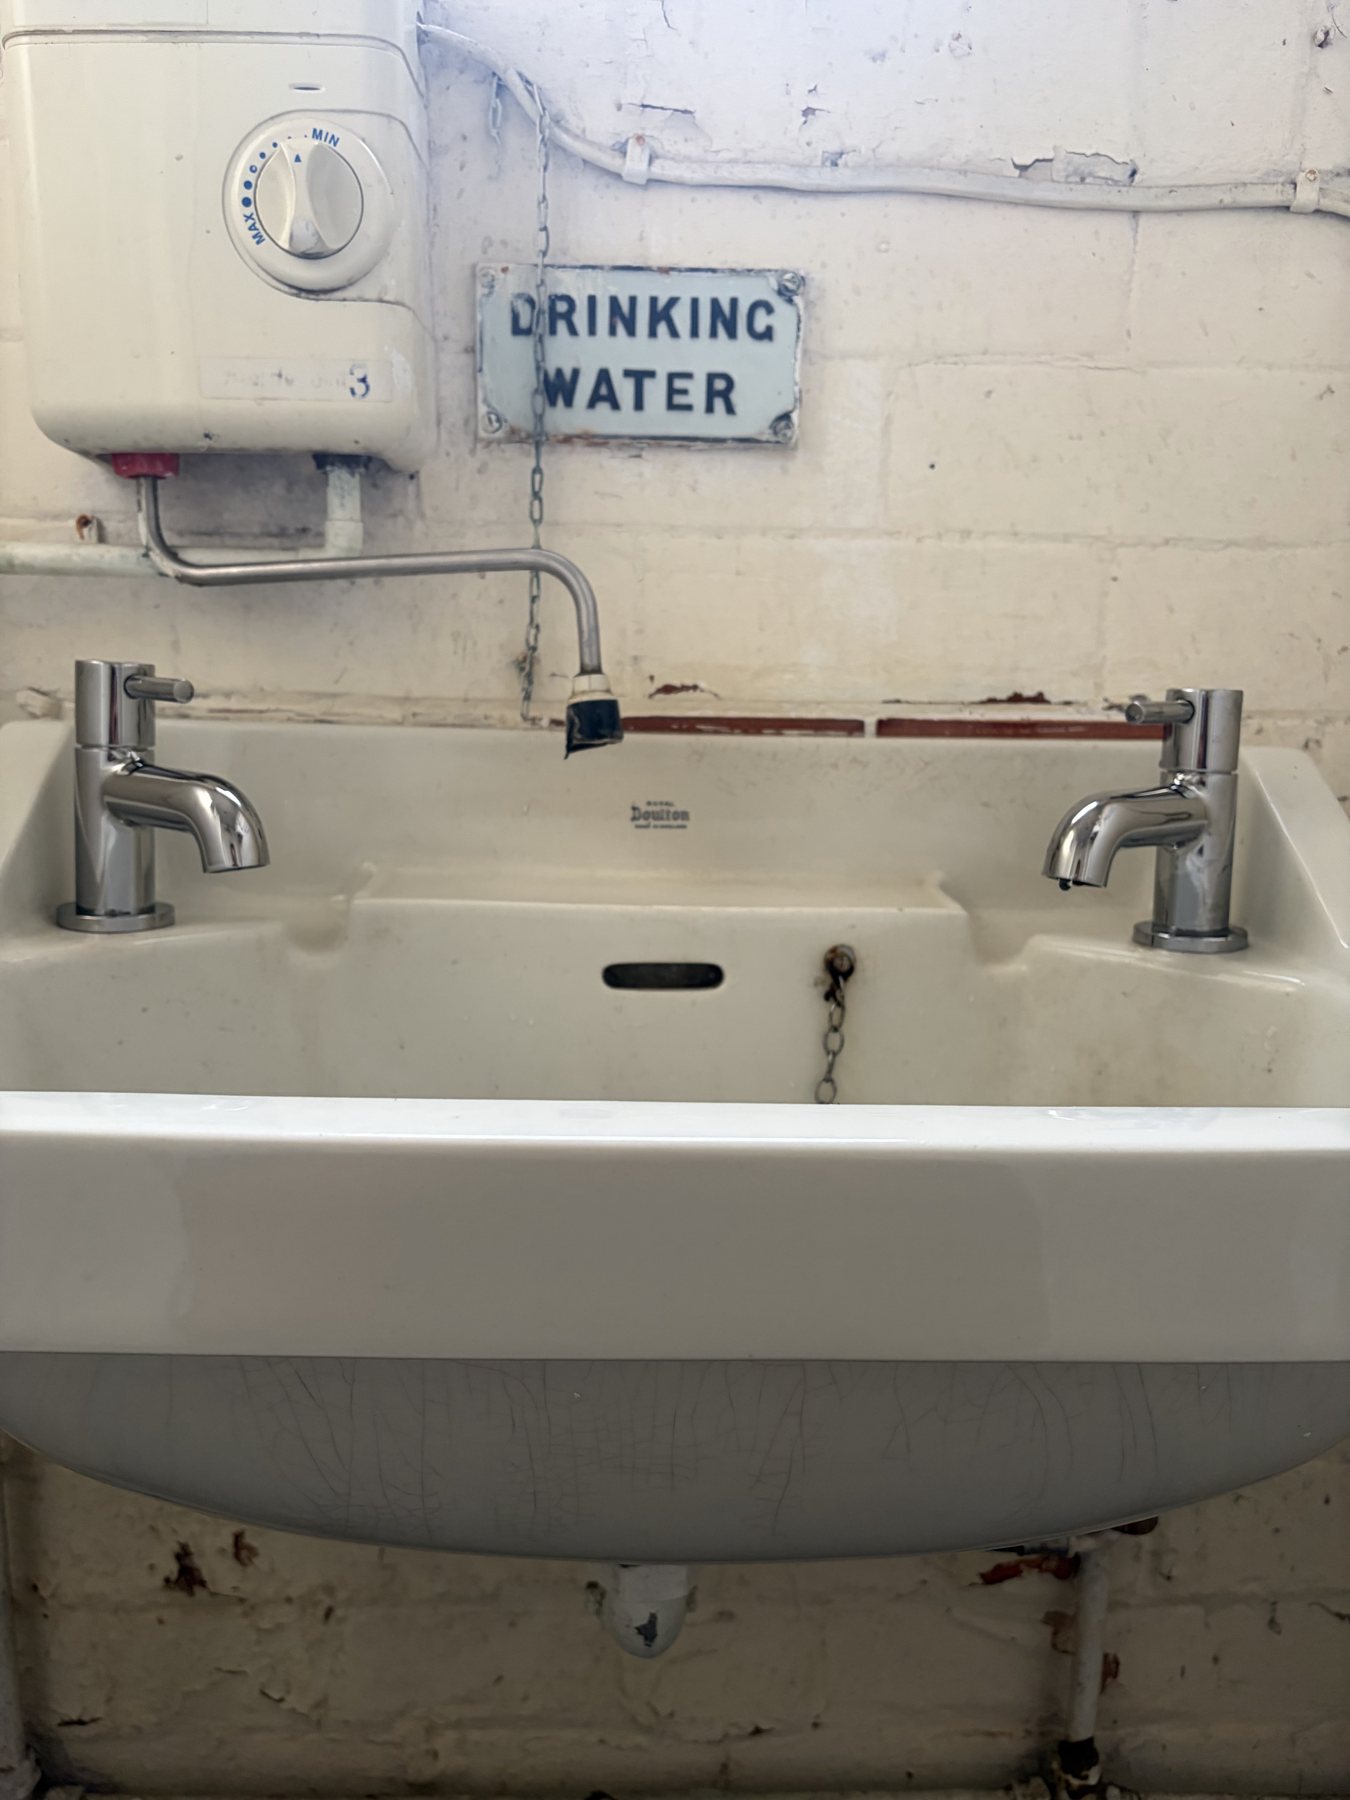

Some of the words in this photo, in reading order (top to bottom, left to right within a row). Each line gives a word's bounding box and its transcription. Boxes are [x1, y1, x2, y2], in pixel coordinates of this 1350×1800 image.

[311, 127, 340, 148] MIN
[243, 212, 266, 246] MAX
[511, 293, 775, 341] DRINKING
[542, 367, 737, 415] WATER
[630, 805, 690, 822] Doulton
